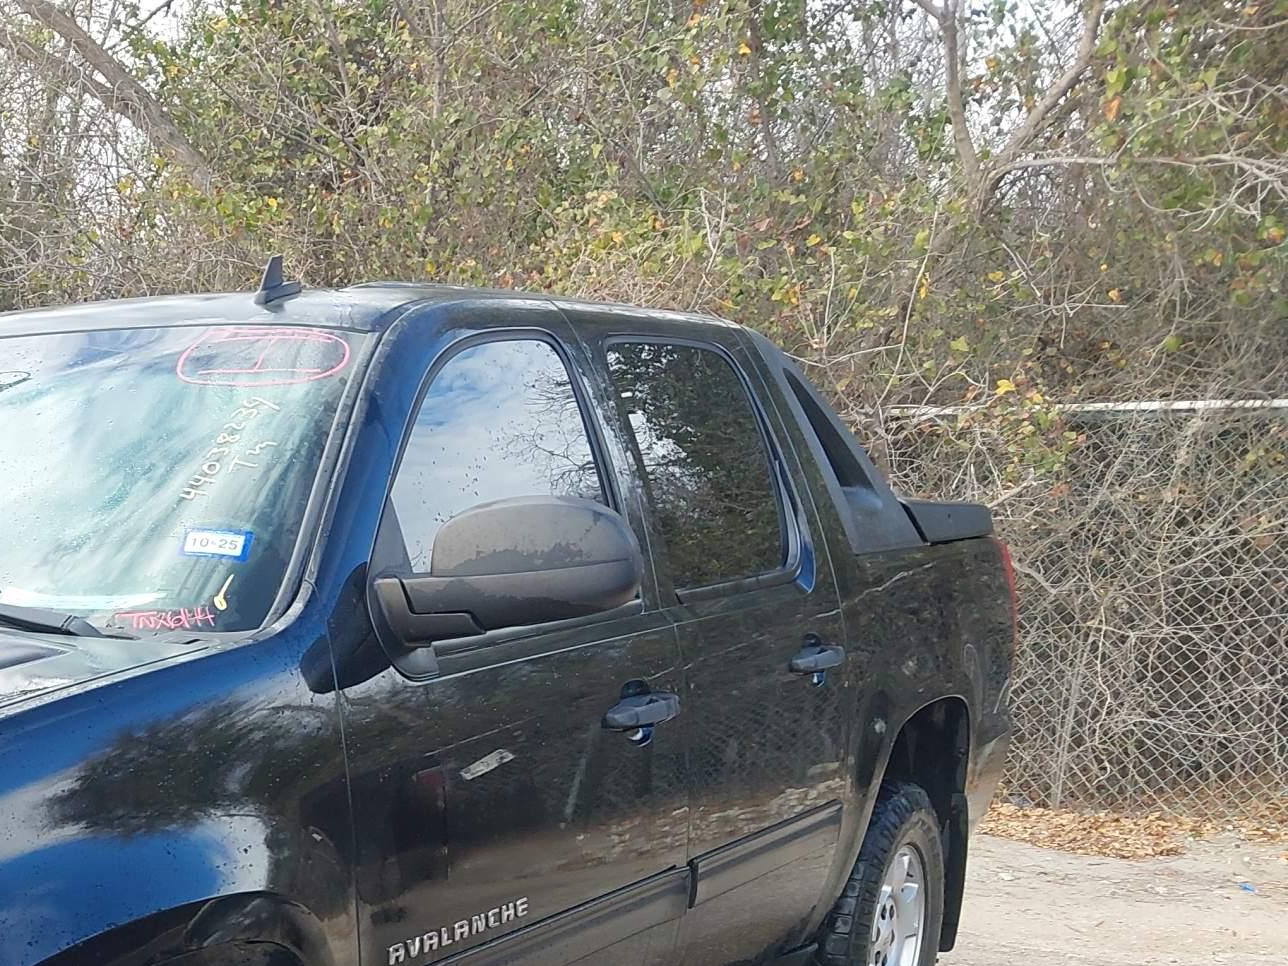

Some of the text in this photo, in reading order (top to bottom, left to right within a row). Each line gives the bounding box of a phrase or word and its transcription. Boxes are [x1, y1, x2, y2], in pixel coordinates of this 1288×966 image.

[179, 396, 281, 500] 44038234
[192, 537, 239, 550] 10-25
[388, 897, 529, 966] AVALANCHE
